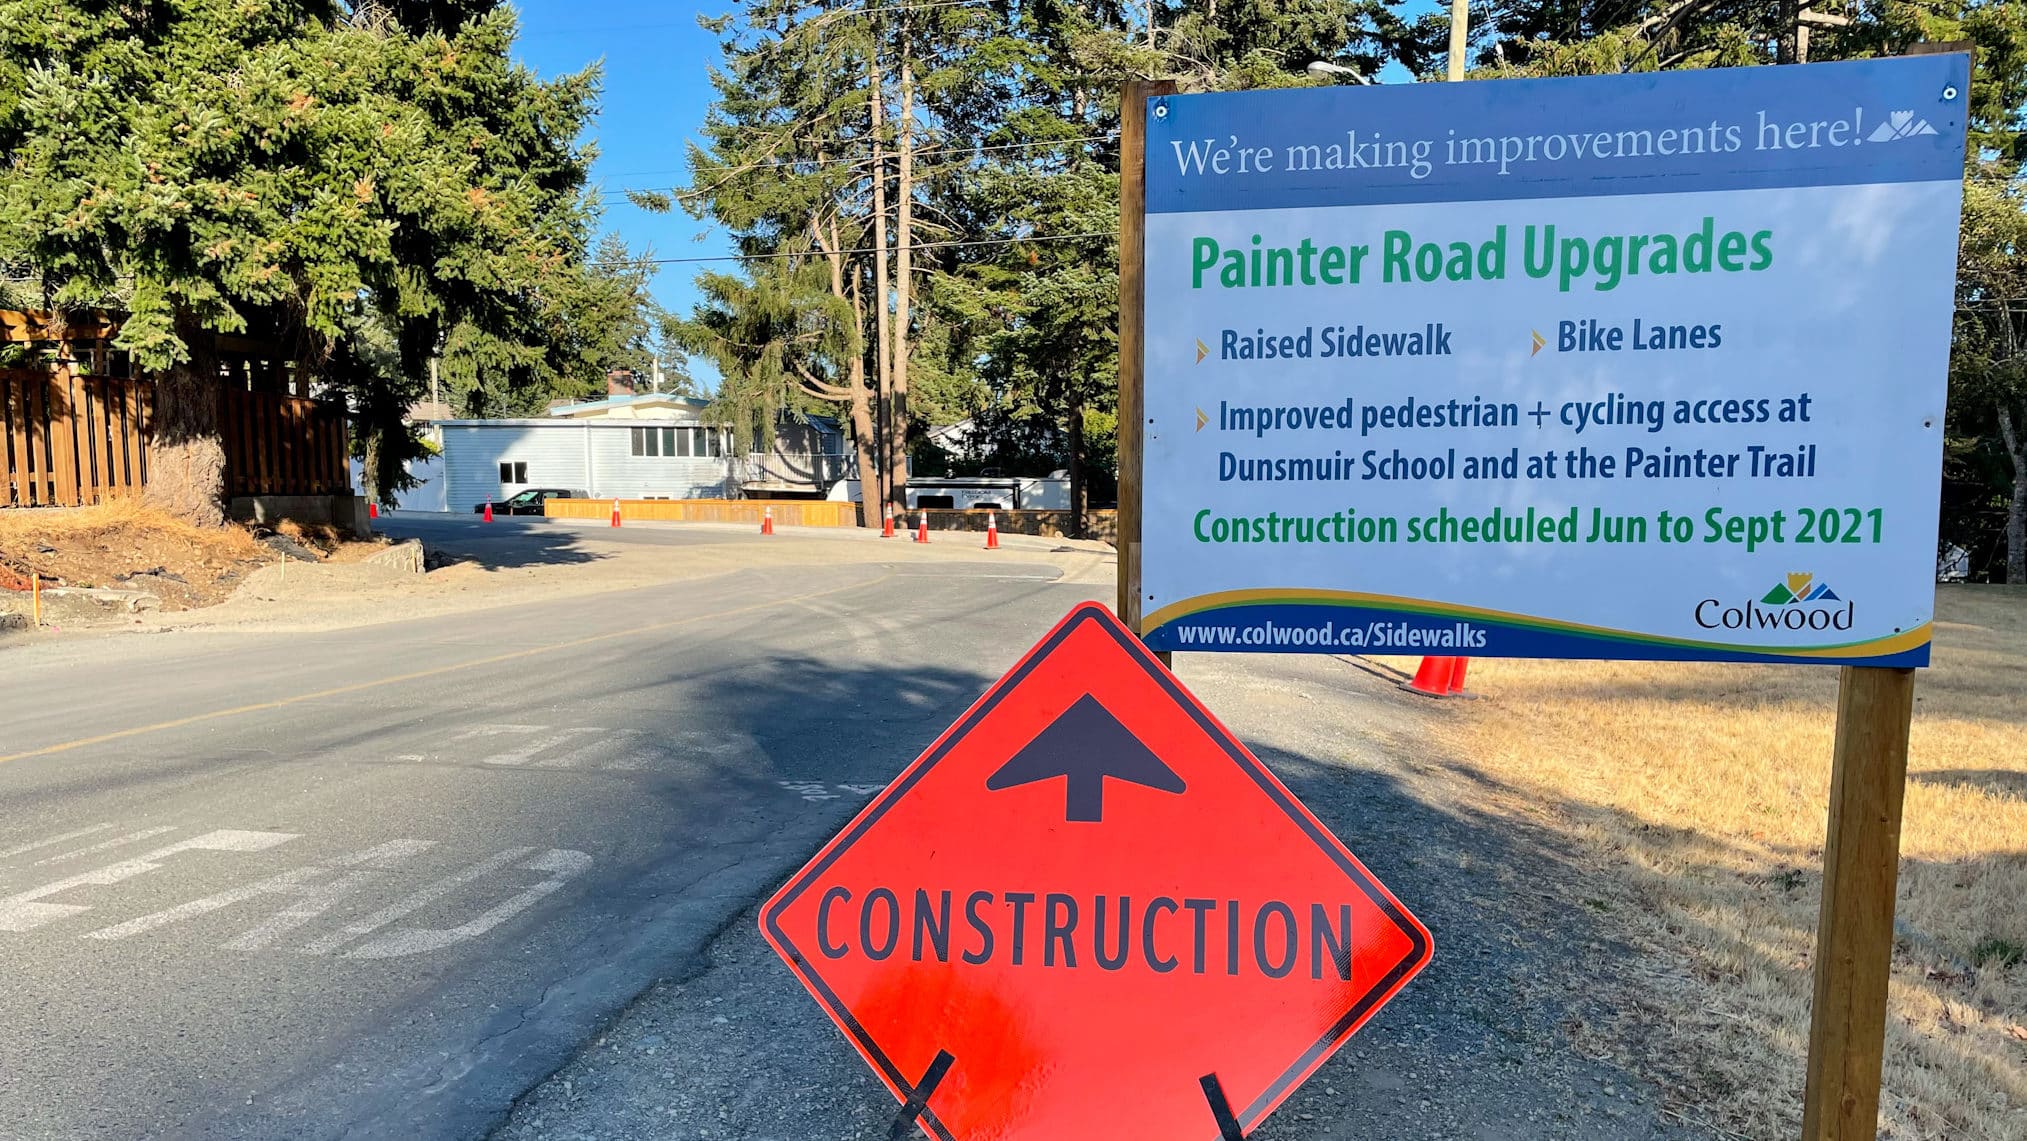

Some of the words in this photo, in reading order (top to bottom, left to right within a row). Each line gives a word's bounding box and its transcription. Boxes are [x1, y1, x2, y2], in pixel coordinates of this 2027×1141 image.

[1170, 135, 1273, 177] We’re
[1285, 130, 1433, 179] making
[1445, 121, 1741, 175] improvements
[1755, 106, 1863, 151] here!
[1192, 234, 1368, 288] Painter
[1383, 224, 1506, 283] Road
[1524, 217, 1773, 292] Upgrades
[1221, 327, 1312, 360] Raised
[1320, 323, 1452, 358] Sidewalk
[1558, 319, 1623, 352] Bike
[1632, 318, 1721, 351] Lanes
[1220, 398, 1352, 437] Improved
[1361, 396, 1518, 436] pedestrian
[1528, 401, 1551, 428] +
[1559, 393, 1664, 434] cycling
[1673, 398, 1769, 424] access
[1778, 393, 1812, 422] at
[1219, 450, 1355, 481] Dunsmuir
[1361, 448, 1455, 481] School
[1463, 448, 1518, 479] and
[1526, 450, 1557, 479] at
[1565, 447, 1616, 478] the
[1625, 445, 1739, 478] Painter
[1747, 444, 1816, 477] Trail
[1193, 507, 1397, 543] Construction
[1407, 506, 1578, 543] scheduled
[1586, 507, 1647, 543] Jun
[1657, 510, 1693, 543] to
[1703, 507, 1786, 552] Sept
[1795, 507, 1882, 543] 2021
[1178, 621, 1487, 648] www.colwood.ca/Sidewalks
[1695, 599, 1853, 631] Colwood
[817, 886, 1352, 981] CONSTRUCTION
